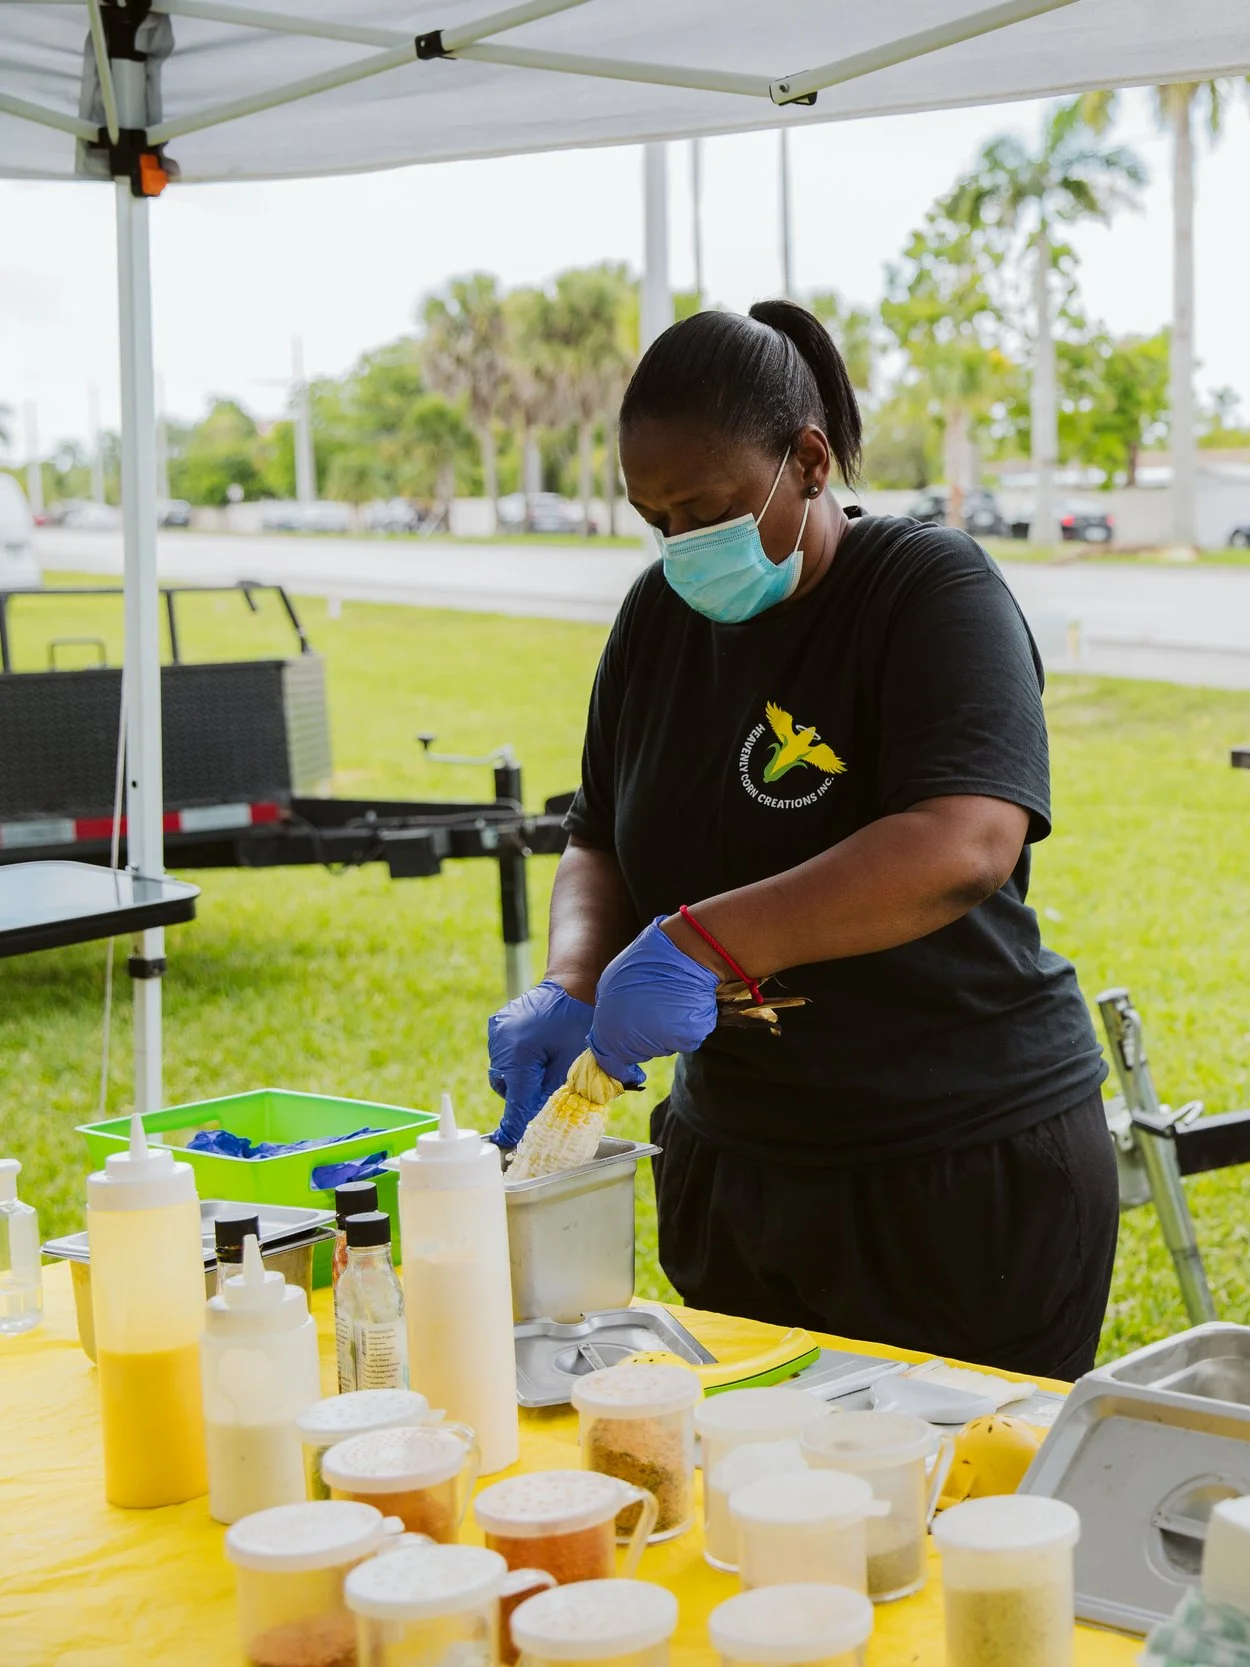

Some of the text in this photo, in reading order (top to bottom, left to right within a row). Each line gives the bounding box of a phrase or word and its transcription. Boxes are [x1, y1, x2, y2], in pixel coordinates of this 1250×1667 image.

[739, 723, 834, 809] HEAVENLY CORN CREATIONS INC.
